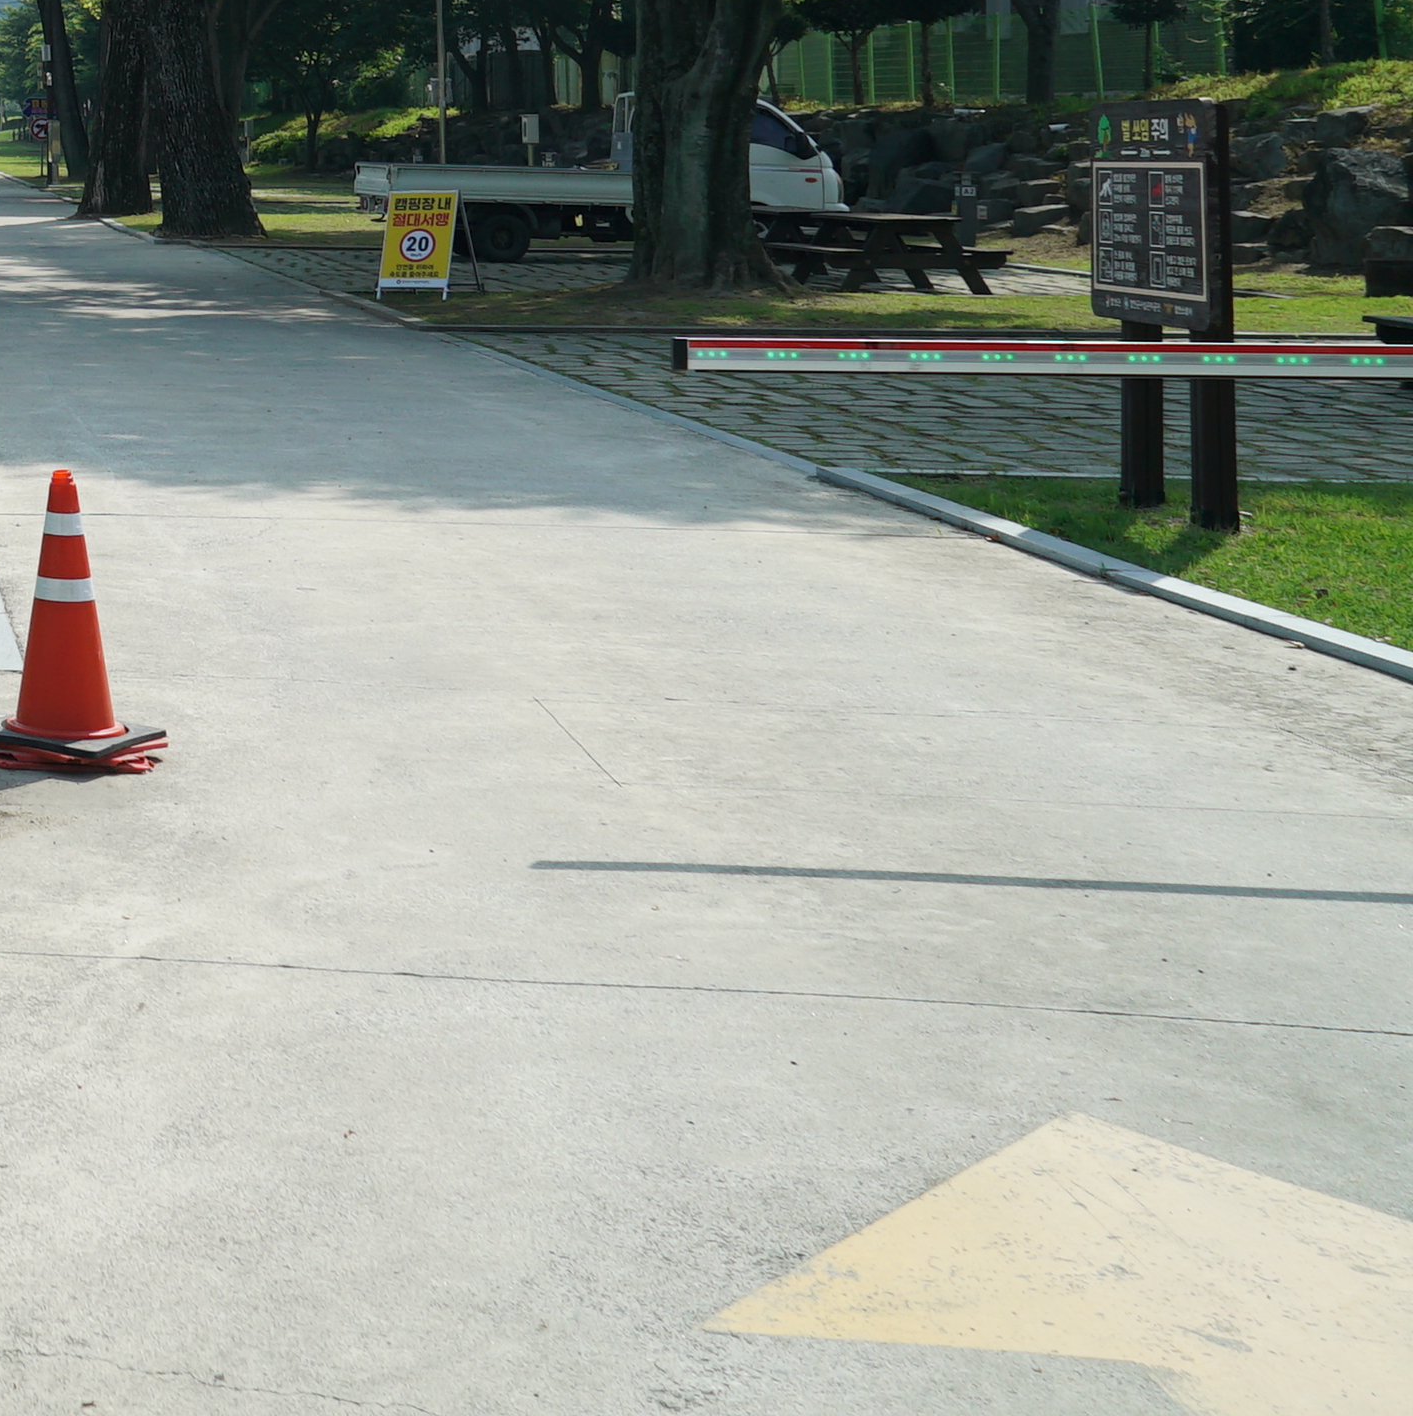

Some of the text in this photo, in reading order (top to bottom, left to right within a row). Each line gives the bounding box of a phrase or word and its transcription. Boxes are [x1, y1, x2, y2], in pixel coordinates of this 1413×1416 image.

[1151, 118, 1169, 142] 주의
[394, 197, 452, 212] 캠핑장 내
[392, 212, 450, 228] 절대서행
[406, 236, 429, 252] 20
